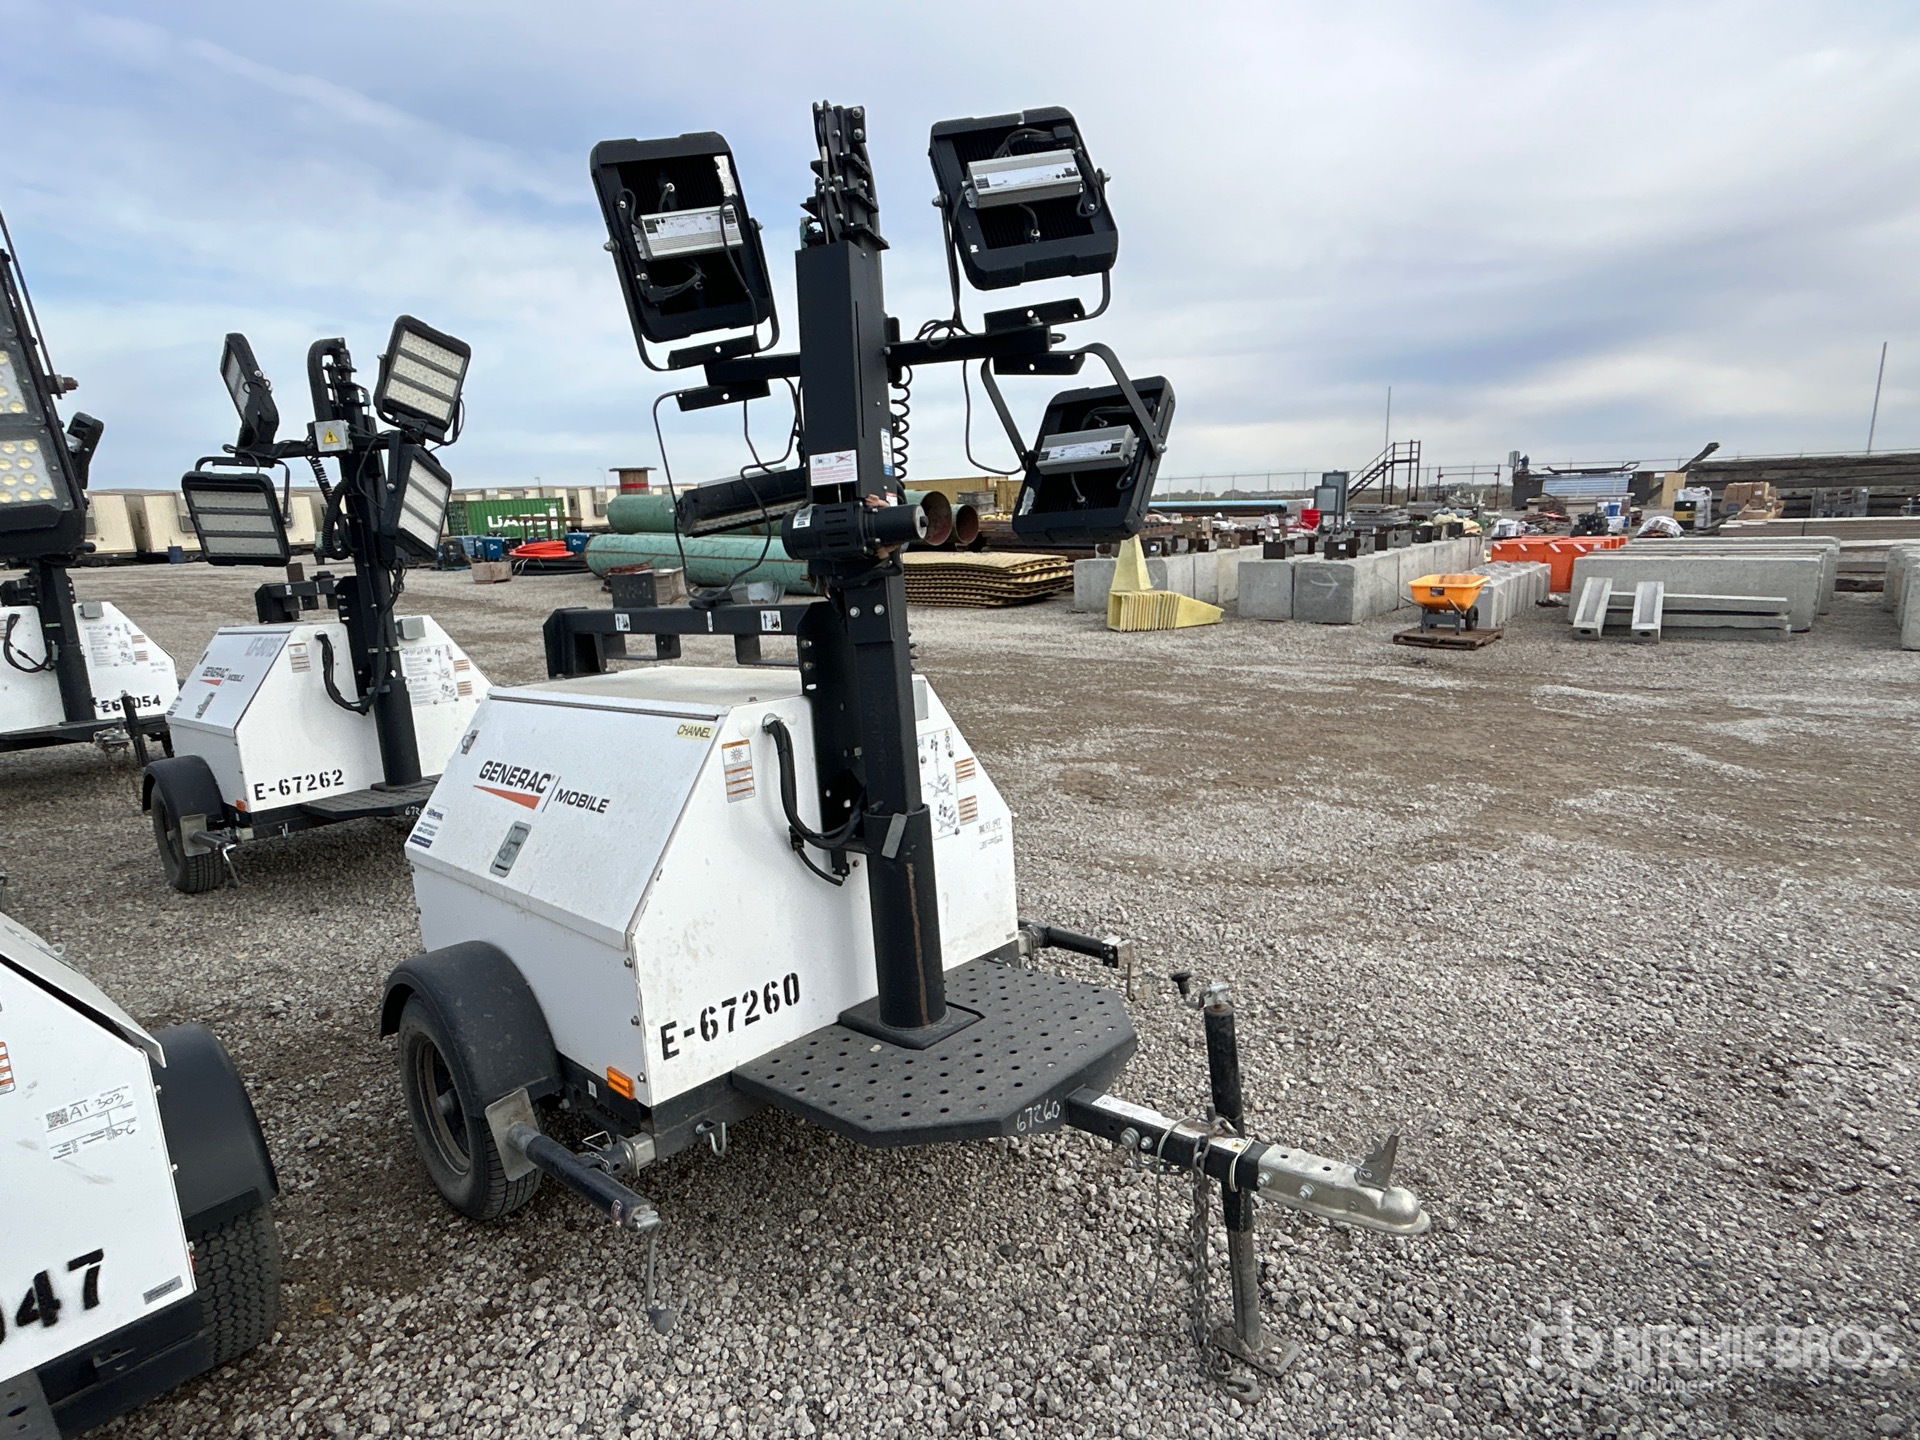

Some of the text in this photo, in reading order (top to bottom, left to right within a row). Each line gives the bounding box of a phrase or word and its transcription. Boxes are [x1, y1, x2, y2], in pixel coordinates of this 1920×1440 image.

[101, 694, 162, 713] E6054
[677, 725, 711, 738] CHANNEL
[253, 769, 345, 801] E-67262
[554, 788, 611, 814] MOBILE
[660, 972, 800, 1061] E-67260
[1016, 1099, 1061, 1132] 67260
